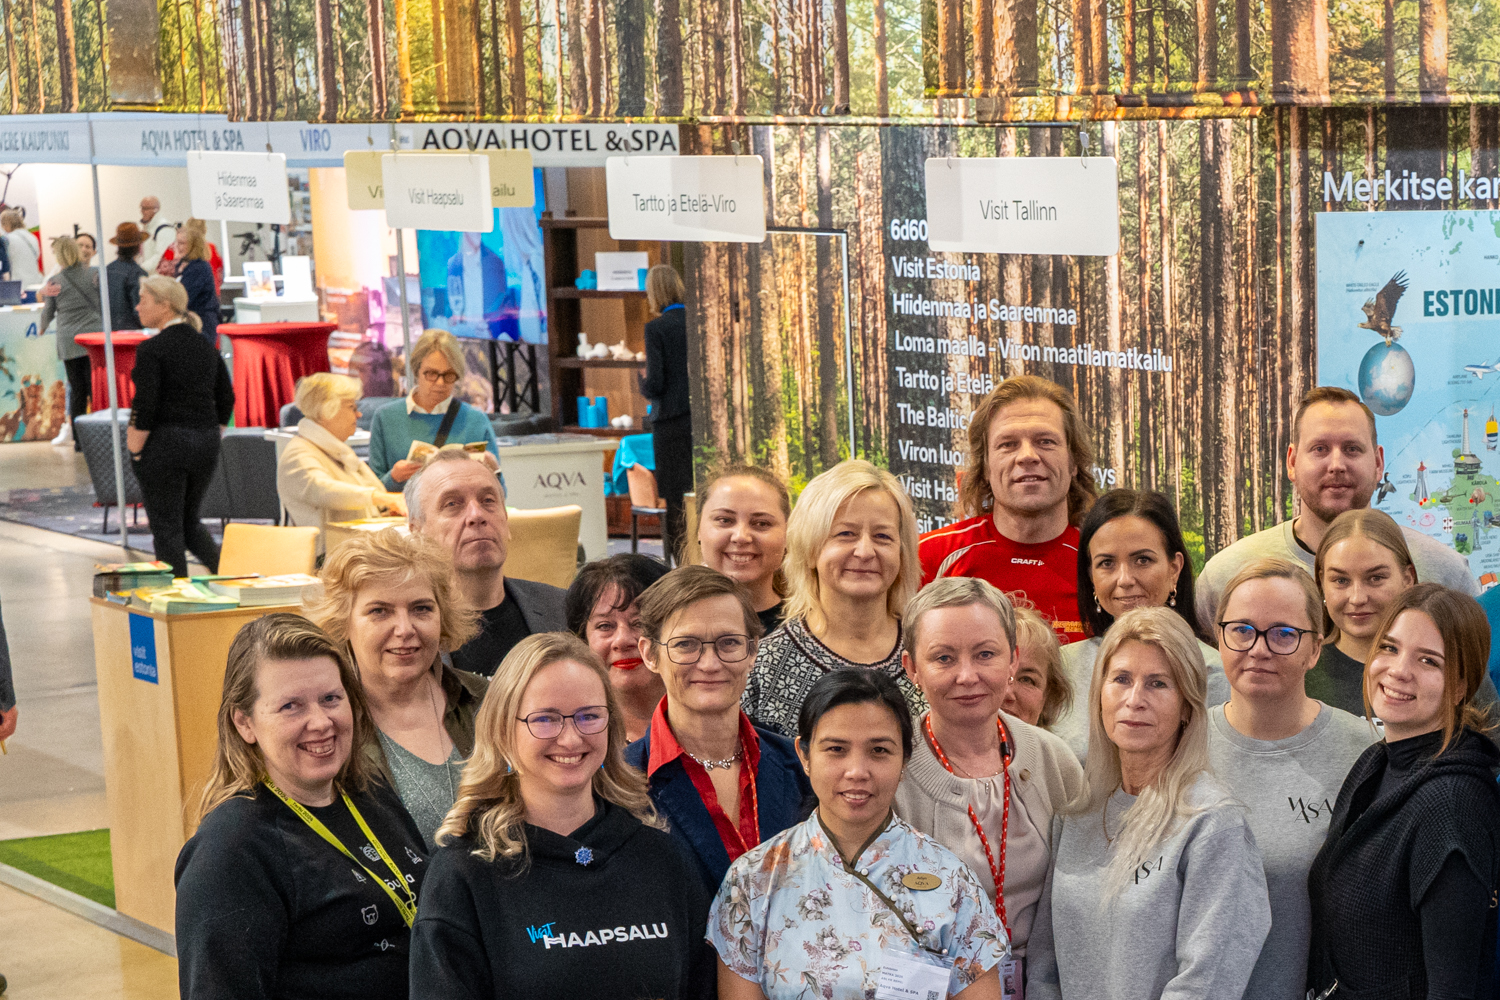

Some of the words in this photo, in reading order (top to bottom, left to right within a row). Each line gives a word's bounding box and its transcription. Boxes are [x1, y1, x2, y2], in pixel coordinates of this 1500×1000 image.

[141, 130, 172, 156] AQVA
[173, 130, 209, 152] HOTEL
[212, 130, 221, 151] &
[223, 130, 245, 152] SPA
[300, 128, 332, 152] VIRO
[511, 129, 598, 151] HOTEL
[605, 130, 622, 151] &
[631, 129, 678, 152] SPA
[218, 171, 257, 188] Hiidenmaa
[1324, 169, 1452, 202] Merkitse
[223, 192, 264, 209] Saarenmaa
[408, 188, 425, 205] Visit
[426, 188, 464, 209] Haapsalu
[632, 194, 665, 212] Tartto
[668, 194, 678, 216] ja
[680, 194, 736, 213] Etelä-Viro
[980, 199, 1009, 222] Visit
[1012, 200, 1058, 222] Tallinn
[890, 218, 928, 242] 6d60
[892, 256, 924, 278] Visit
[926, 258, 981, 282] Estonia
[892, 294, 971, 321] Hiidenmaa
[973, 299, 987, 324] ja
[989, 298, 1077, 326] Saarenmaa
[896, 331, 935, 353] Loma
[937, 334, 986, 358] maalla
[998, 338, 1040, 362] Viron
[1042, 343, 1173, 373] maatilamatkailu
[896, 366, 940, 391] Tartto
[940, 370, 954, 395] ja
[897, 403, 925, 426] The
[926, 406, 968, 431] Baltic
[898, 440, 936, 464] Viron
[533, 472, 586, 490] AQVA
[901, 474, 931, 500] Visit
[1010, 558, 1038, 566] CRAFT
[526, 921, 556, 944] Visit
[543, 922, 668, 949] HAAPSALU
